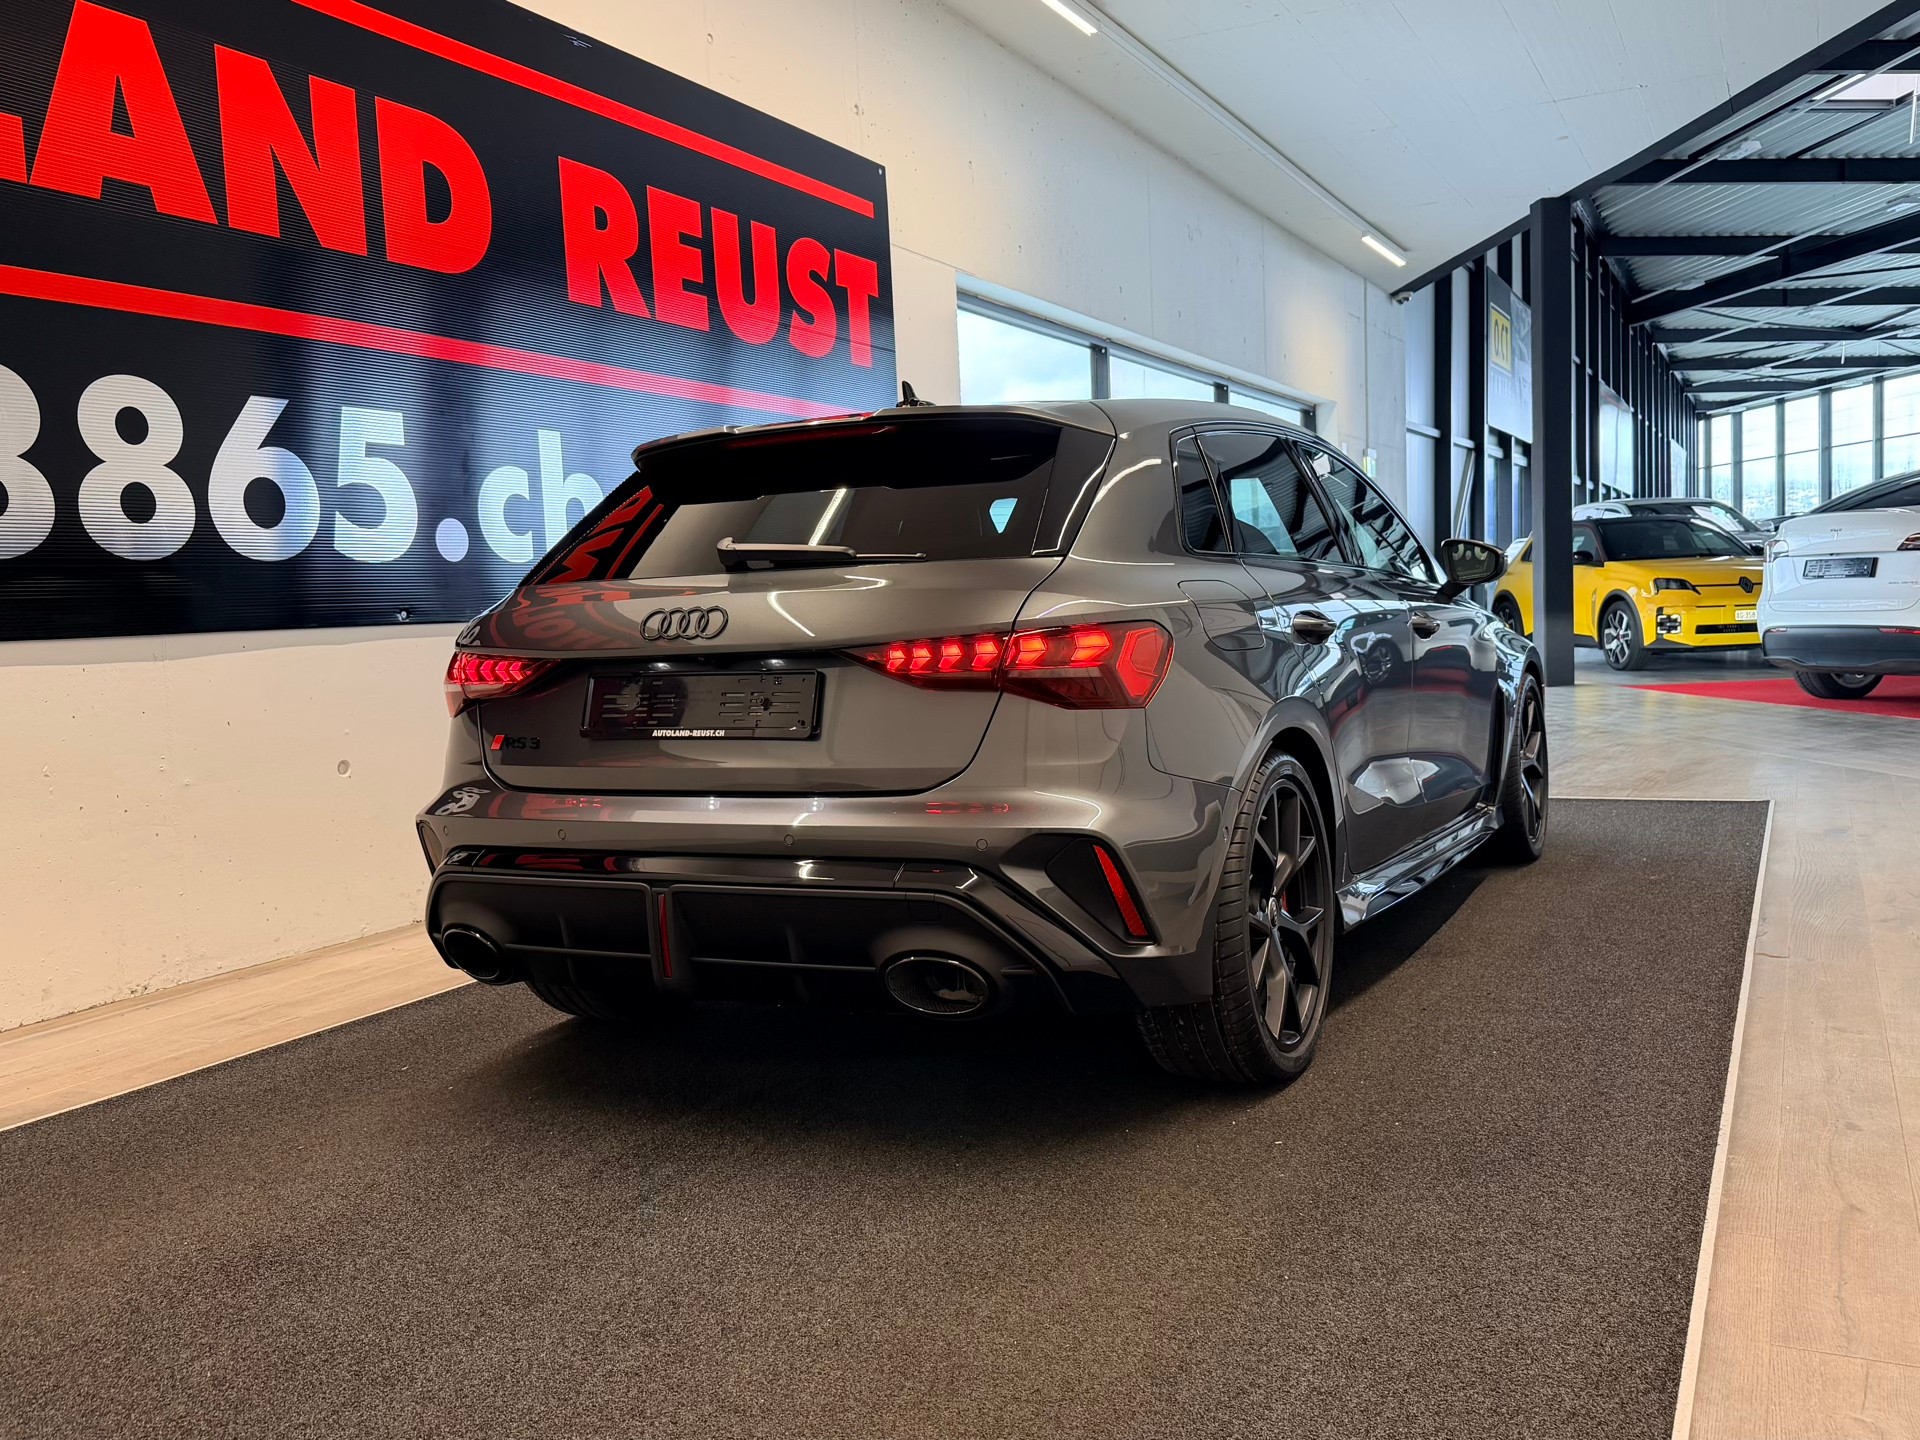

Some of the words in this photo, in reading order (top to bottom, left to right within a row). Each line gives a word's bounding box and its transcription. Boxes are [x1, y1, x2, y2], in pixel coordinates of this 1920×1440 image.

[0, 0, 492, 275] AND
[558, 156, 879, 367] REUST
[652, 729, 725, 737] AUTOLAND-REUST.CH
